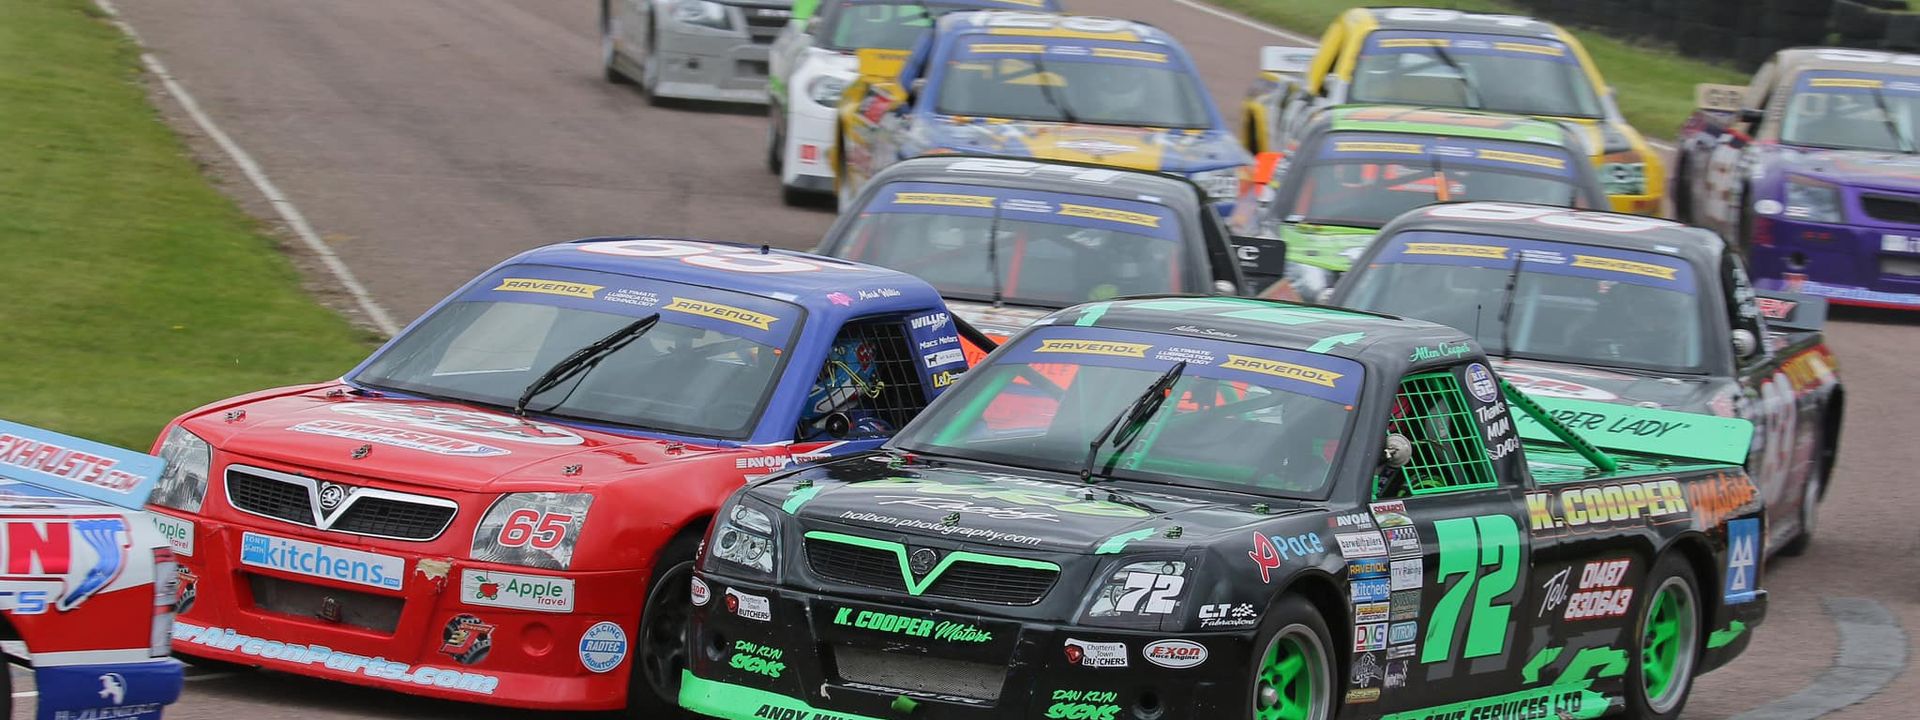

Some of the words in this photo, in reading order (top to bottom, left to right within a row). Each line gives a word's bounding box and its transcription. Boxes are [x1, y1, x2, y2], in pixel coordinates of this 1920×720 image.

[505, 280, 589, 296] RAVENOL
[617, 289, 658, 298] ULTIMATE
[603, 296, 655, 307] TECHNOLOGY
[607, 292, 660, 303] LUBRICATION
[675, 301, 764, 325] RAVENOL
[911, 313, 946, 330] WILLIS
[919, 340, 939, 350] Macs
[939, 336, 958, 345] Motors
[1049, 341, 1137, 355] RAVENOL
[1169, 346, 1212, 355] ULTIMATE
[1155, 355, 1212, 365] TECHNOLOGY
[1158, 350, 1215, 361] LUBRICATION
[1408, 346, 1440, 362] Allen
[1233, 358, 1328, 382] RAVENOL
[1475, 400, 1506, 423] Thanks
[312, 420, 474, 449] SIMPSON
[1487, 416, 1510, 441] MUM
[747, 456, 787, 468] AVON
[1525, 493, 1564, 531] K.
[1561, 479, 1689, 527] COOPER
[1336, 512, 1370, 527] AVON
[498, 508, 574, 550] 65
[266, 538, 384, 584] kitchens
[1349, 563, 1387, 575] RAVENOL
[1579, 560, 1631, 589] 01487
[505, 579, 563, 599] Apple
[692, 584, 706, 596] on
[1115, 571, 1184, 614] 72
[1357, 580, 1391, 597] kitchens
[1420, 514, 1520, 664] 72
[537, 596, 567, 607] Travel
[1563, 588, 1634, 619] 830643
[739, 607, 770, 619] BUTCHERS
[834, 606, 852, 626] K.
[854, 610, 936, 638] COOPER
[934, 620, 993, 643] Motors
[1200, 618, 1256, 628] Fabrications
[589, 625, 621, 639] RACING
[585, 640, 621, 652] RADTEC
[734, 639, 757, 656] DAN
[756, 645, 783, 661] KLYN
[1152, 646, 1201, 656] Exon
[584, 652, 620, 668] RADIATORS
[728, 652, 787, 679] SIGNS
[1052, 689, 1082, 701] DAN
[1082, 690, 1119, 703] KLYN
[755, 704, 809, 720] ANDY
[1044, 702, 1122, 720] SIGNS
[1469, 695, 1550, 720] SERVICES
[1554, 690, 1583, 713] LTD
